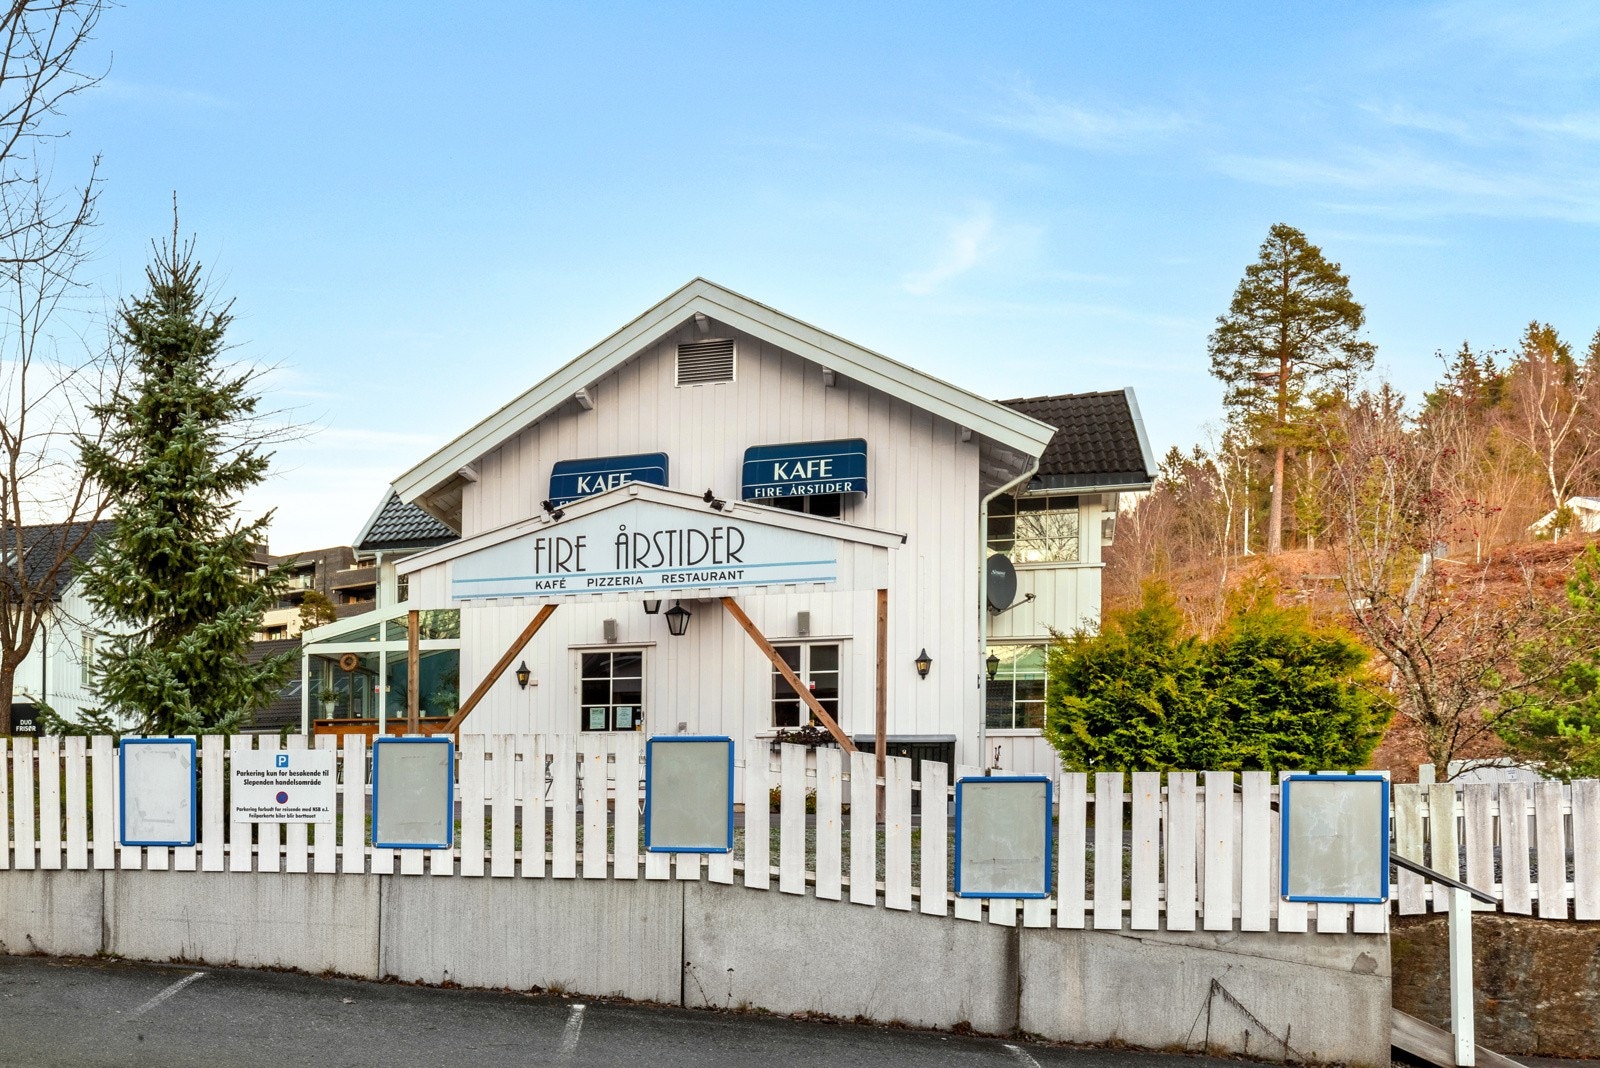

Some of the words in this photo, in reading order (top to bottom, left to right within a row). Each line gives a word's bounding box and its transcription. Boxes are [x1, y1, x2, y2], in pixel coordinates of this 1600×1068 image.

[773, 459, 833, 481] KAFE
[754, 486, 783, 498] FIRE
[789, 481, 853, 496] ÅRSTIDER
[534, 535, 587, 574] FIRE
[615, 524, 745, 570] ÅRSTIDER
[535, 577, 567, 590] KAFÉ
[587, 575, 644, 588] PIZZERIA
[661, 570, 745, 584] RESTAURANT
[275, 778, 322, 786] handelsområde
